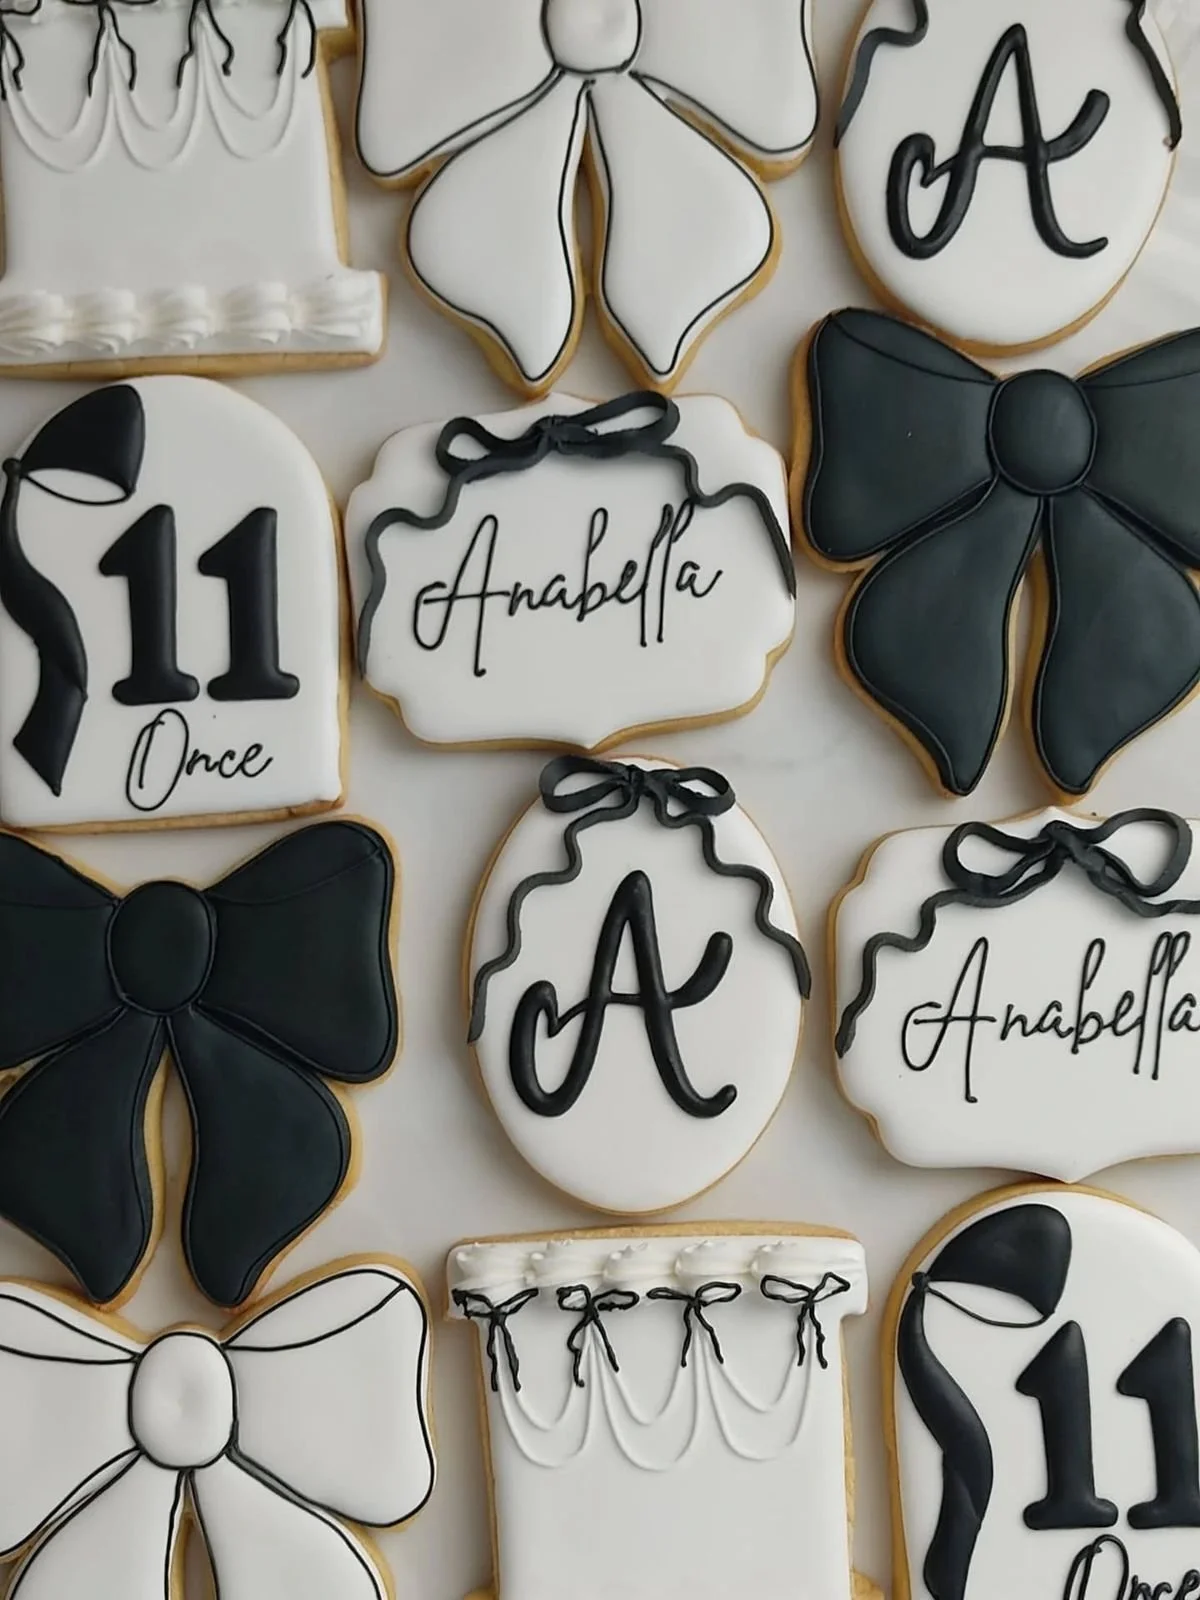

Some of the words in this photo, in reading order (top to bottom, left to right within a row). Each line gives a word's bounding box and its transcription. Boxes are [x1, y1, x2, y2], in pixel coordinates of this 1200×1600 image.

[886, 23, 1110, 260] A
[98, 504, 300, 706] 11
[413, 497, 723, 677] Anabella
[125, 708, 273, 812] Once
[508, 869, 737, 1119] A
[901, 930, 1200, 1103] Anabella
[1015, 1316, 1200, 1530] 11
